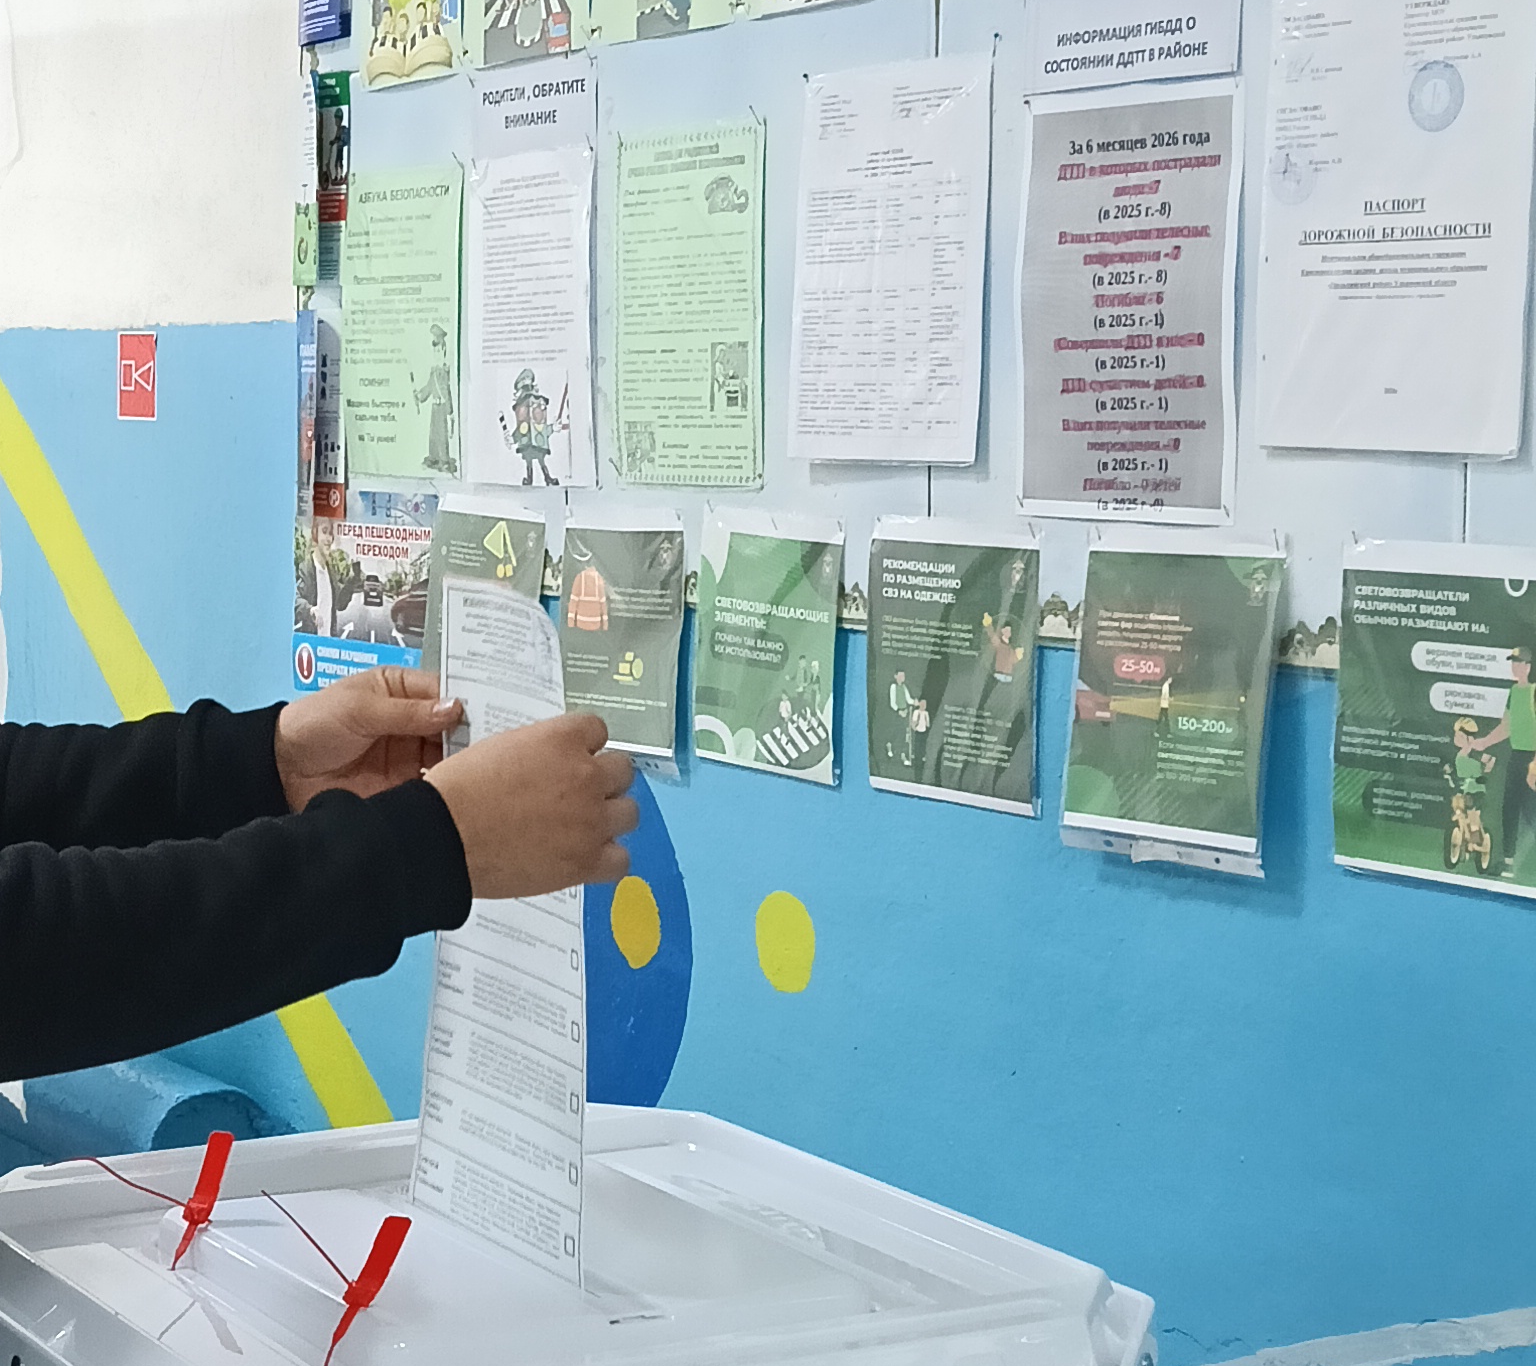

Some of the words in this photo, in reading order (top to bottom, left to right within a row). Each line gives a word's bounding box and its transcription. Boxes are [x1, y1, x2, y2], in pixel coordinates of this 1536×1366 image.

[1057, 23, 1142, 47] ИНФОРМАЦИЯ
[1144, 19, 1183, 37] ГИБДД
[1186, 16, 1197, 30] О
[1044, 53, 1114, 74] СОСТОЯНИИ
[1116, 49, 1147, 69] ДДТТ
[1149, 47, 1155, 62] В
[1158, 41, 1209, 60] РАЙОНЕ
[482, 89, 525, 108] РОДИТЕЛИ
[532, 78, 587, 99] ОБРАТИТЕ
[504, 109, 558, 130] ВНИМАНИЕ
[1069, 140, 1083, 155] За
[1086, 139, 1094, 154] 6
[1097, 137, 1147, 154] месяцев
[1151, 131, 1179, 148] 2026
[1182, 131, 1210, 146] года
[1152, 154, 1222, 173] пострадали
[358, 190, 388, 204] АЗБУКА
[390, 185, 450, 202] БЕЗОПАСНОСТИ
[1098, 206, 1111, 223] (в
[1113, 203, 1142, 220] 2025
[1364, 198, 1426, 214] ПАСПОРТ
[1299, 225, 1375, 244] ДОРОЖНОЙ
[1382, 223, 1492, 239] БЕЗОПАСНОСТИ
[1092, 273, 1104, 290] (в
[1108, 271, 1135, 286] 2025
[1094, 315, 1106, 331] (в
[1108, 314, 1136, 329] 2025
[1095, 356, 1107, 372] (в
[1110, 355, 1137, 370] 2025
[1095, 398, 1107, 413] (в
[1110, 397, 1137, 411] 2025
[1154, 420, 1207, 431] телесные
[1087, 440, 1161, 453] повреждения
[1097, 458, 1109, 474] (в
[1111, 458, 1138, 471] 2025
[337, 524, 363, 538] ПЕРЕД
[365, 526, 431, 542] ПЕШЕХОДНЫМ
[356, 543, 409, 560] ПЕРЕХОДОМ
[883, 558, 955, 574] РЕКОМЕНДАЦИИ
[883, 574, 894, 583] ПО
[897, 574, 962, 590] РАЗМЕЩЕНИЮ
[883, 588, 898, 598] СВЭ
[900, 590, 912, 600] НА
[914, 591, 956, 604] ОДЕЖДЕ:
[1354, 585, 1470, 602] СВЕТОВОЗВРАЩАТЕЛИ
[715, 596, 830, 623] СВЕТОВОЗВРАЩАЮЩИЕ
[1354, 600, 1417, 614] РАЗЛИЧНЫХ
[1420, 605, 1457, 617] ВИДОВ
[714, 611, 767, 629] ЭЛЕМЕНТЫ:
[1354, 615, 1399, 627] ОБЫЧНО
[1401, 618, 1470, 633] РАЗМЕЩАЮТ
[1472, 622, 1490, 634] НА:
[715, 632, 743, 644] ПОЧЕМУ
[744, 636, 756, 647] ТАК
[757, 638, 784, 651] ВАЖНО
[726, 646, 782, 663] ИСПОЛЬЗОВАТЬ?
